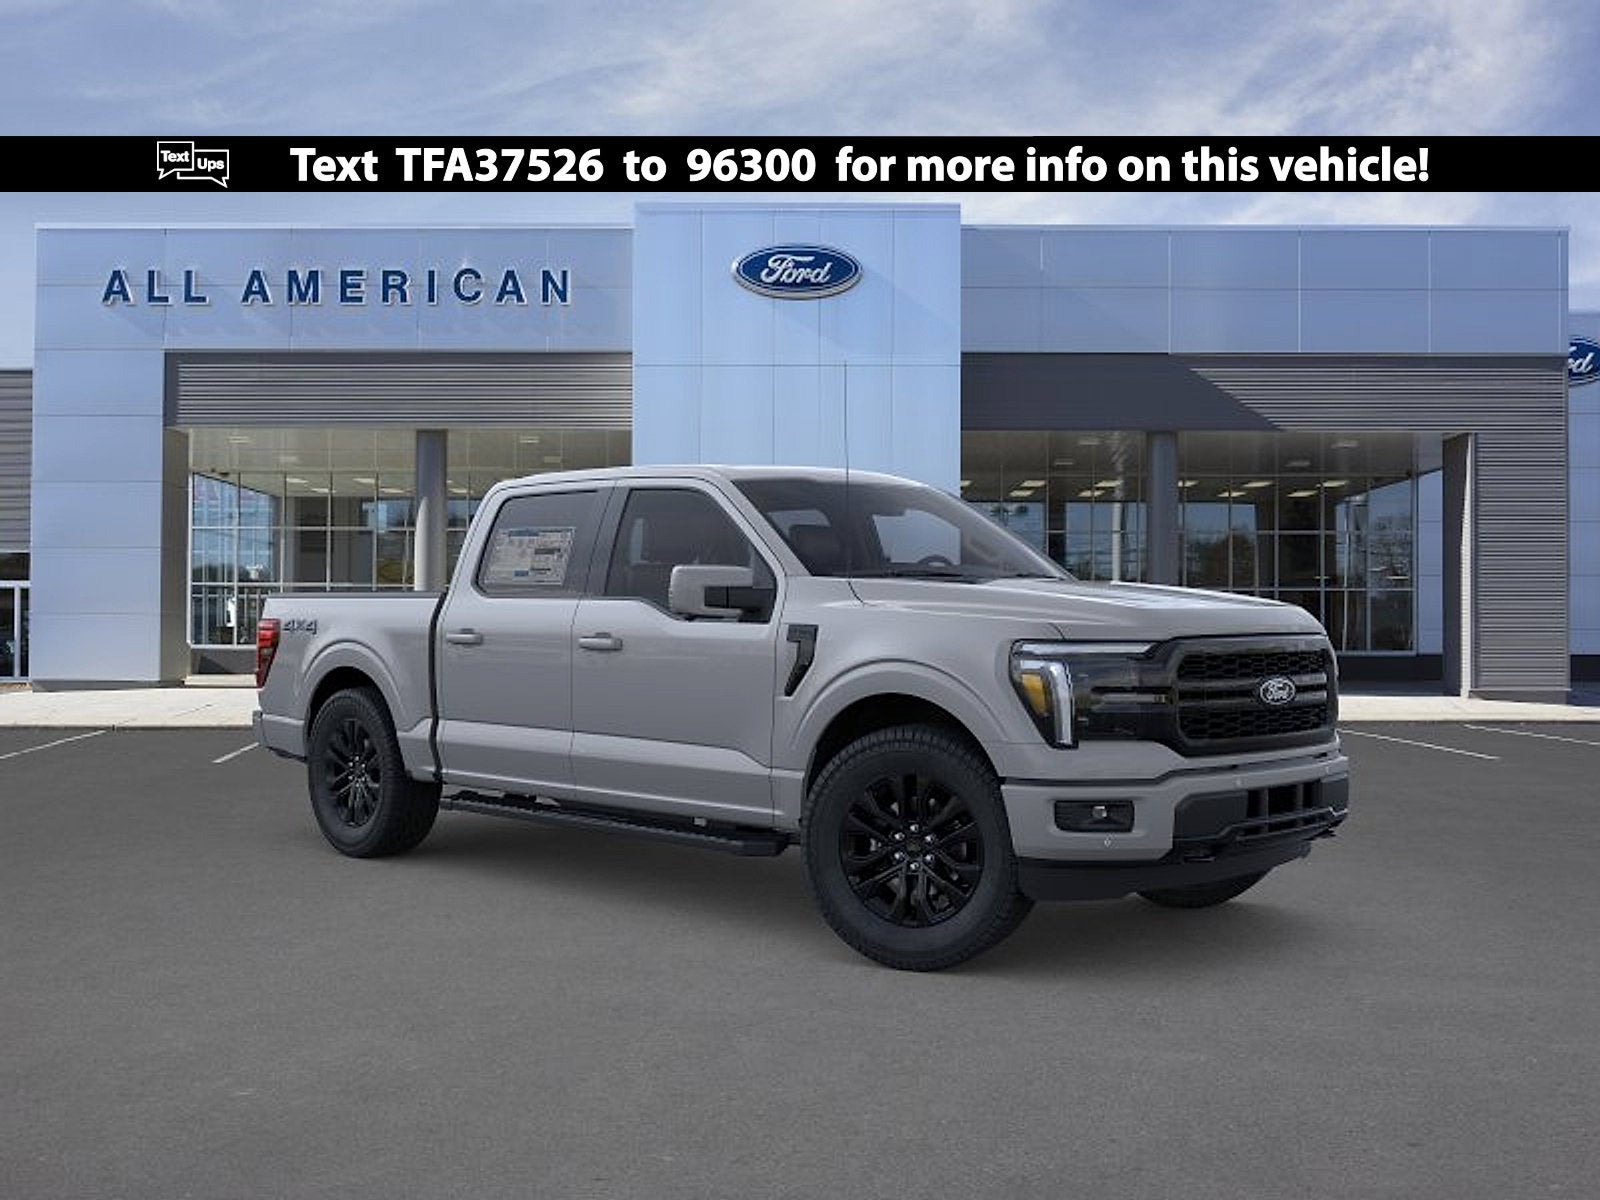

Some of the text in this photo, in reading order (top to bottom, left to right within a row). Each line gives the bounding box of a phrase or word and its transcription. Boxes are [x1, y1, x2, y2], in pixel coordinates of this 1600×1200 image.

[761, 254, 833, 283] Ford
[103, 268, 571, 306] ALL AMERICAN
